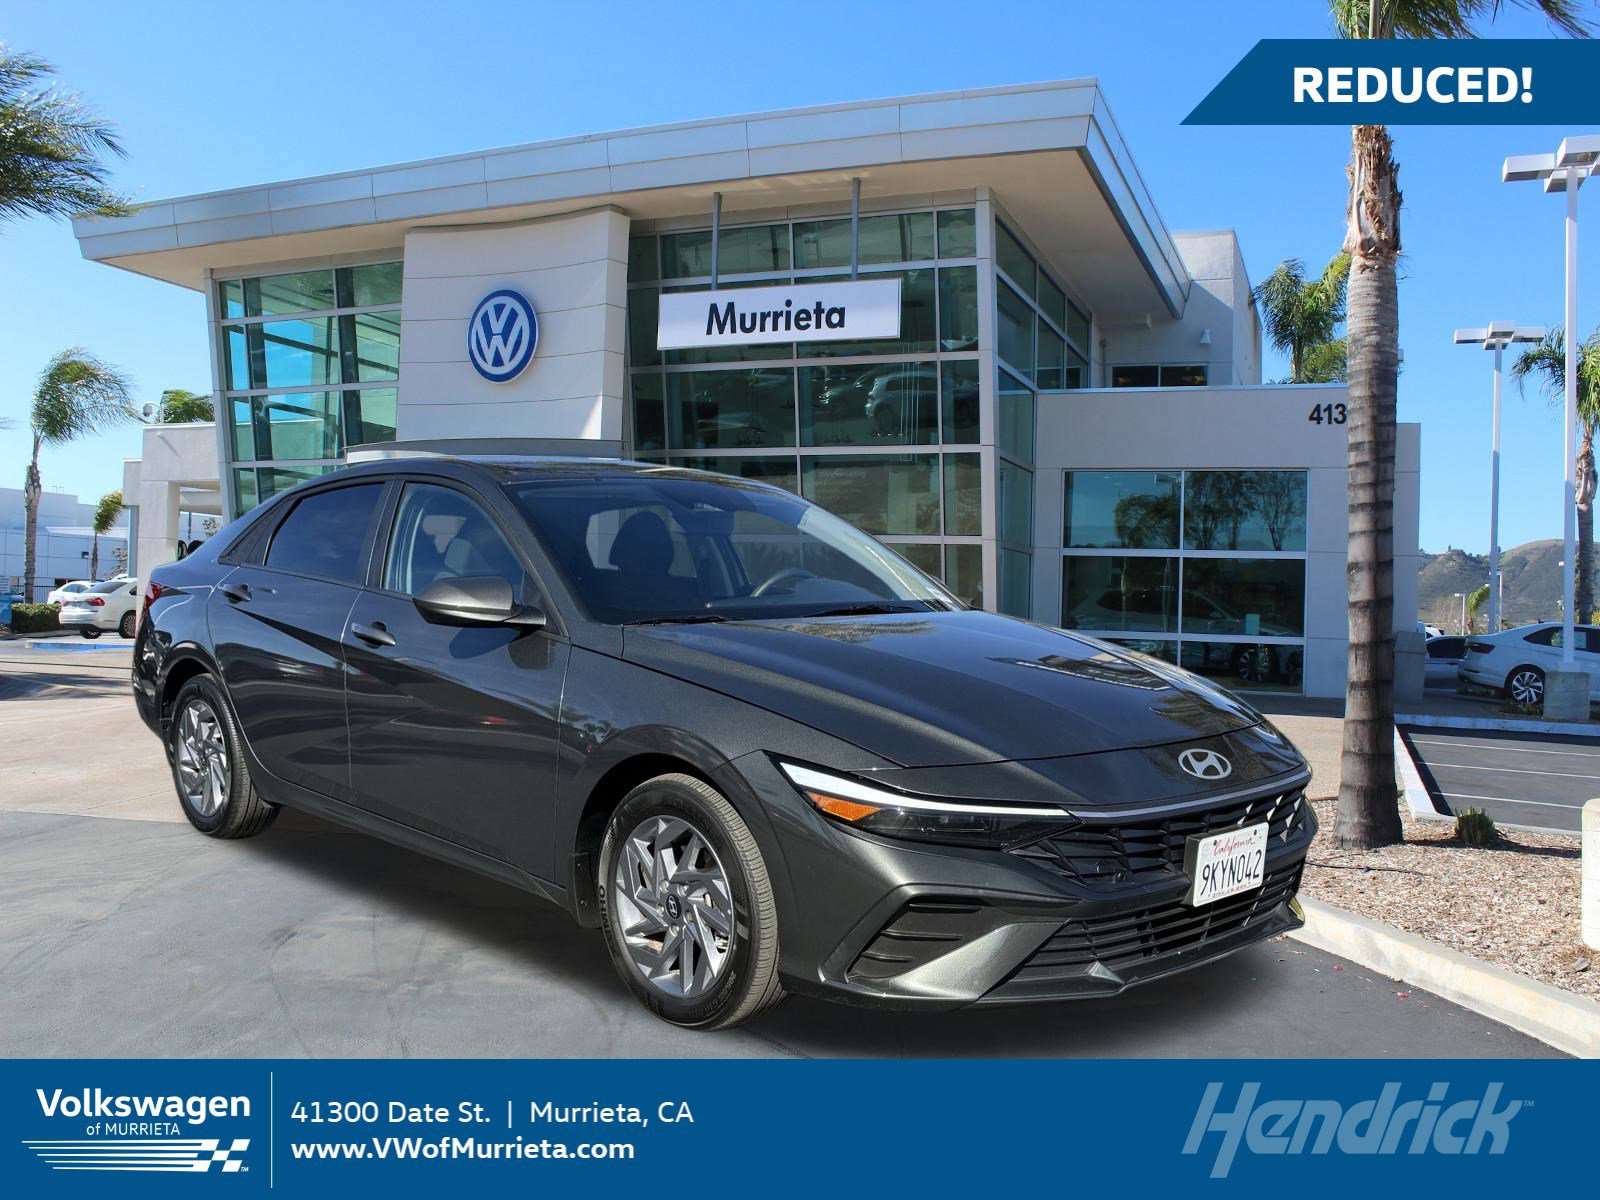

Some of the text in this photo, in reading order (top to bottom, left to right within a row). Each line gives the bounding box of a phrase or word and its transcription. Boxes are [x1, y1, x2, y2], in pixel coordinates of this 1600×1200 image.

[705, 299, 846, 335] Murrieta
[1213, 837, 1256, 856] California
[1201, 849, 1262, 895] 9KYN042
